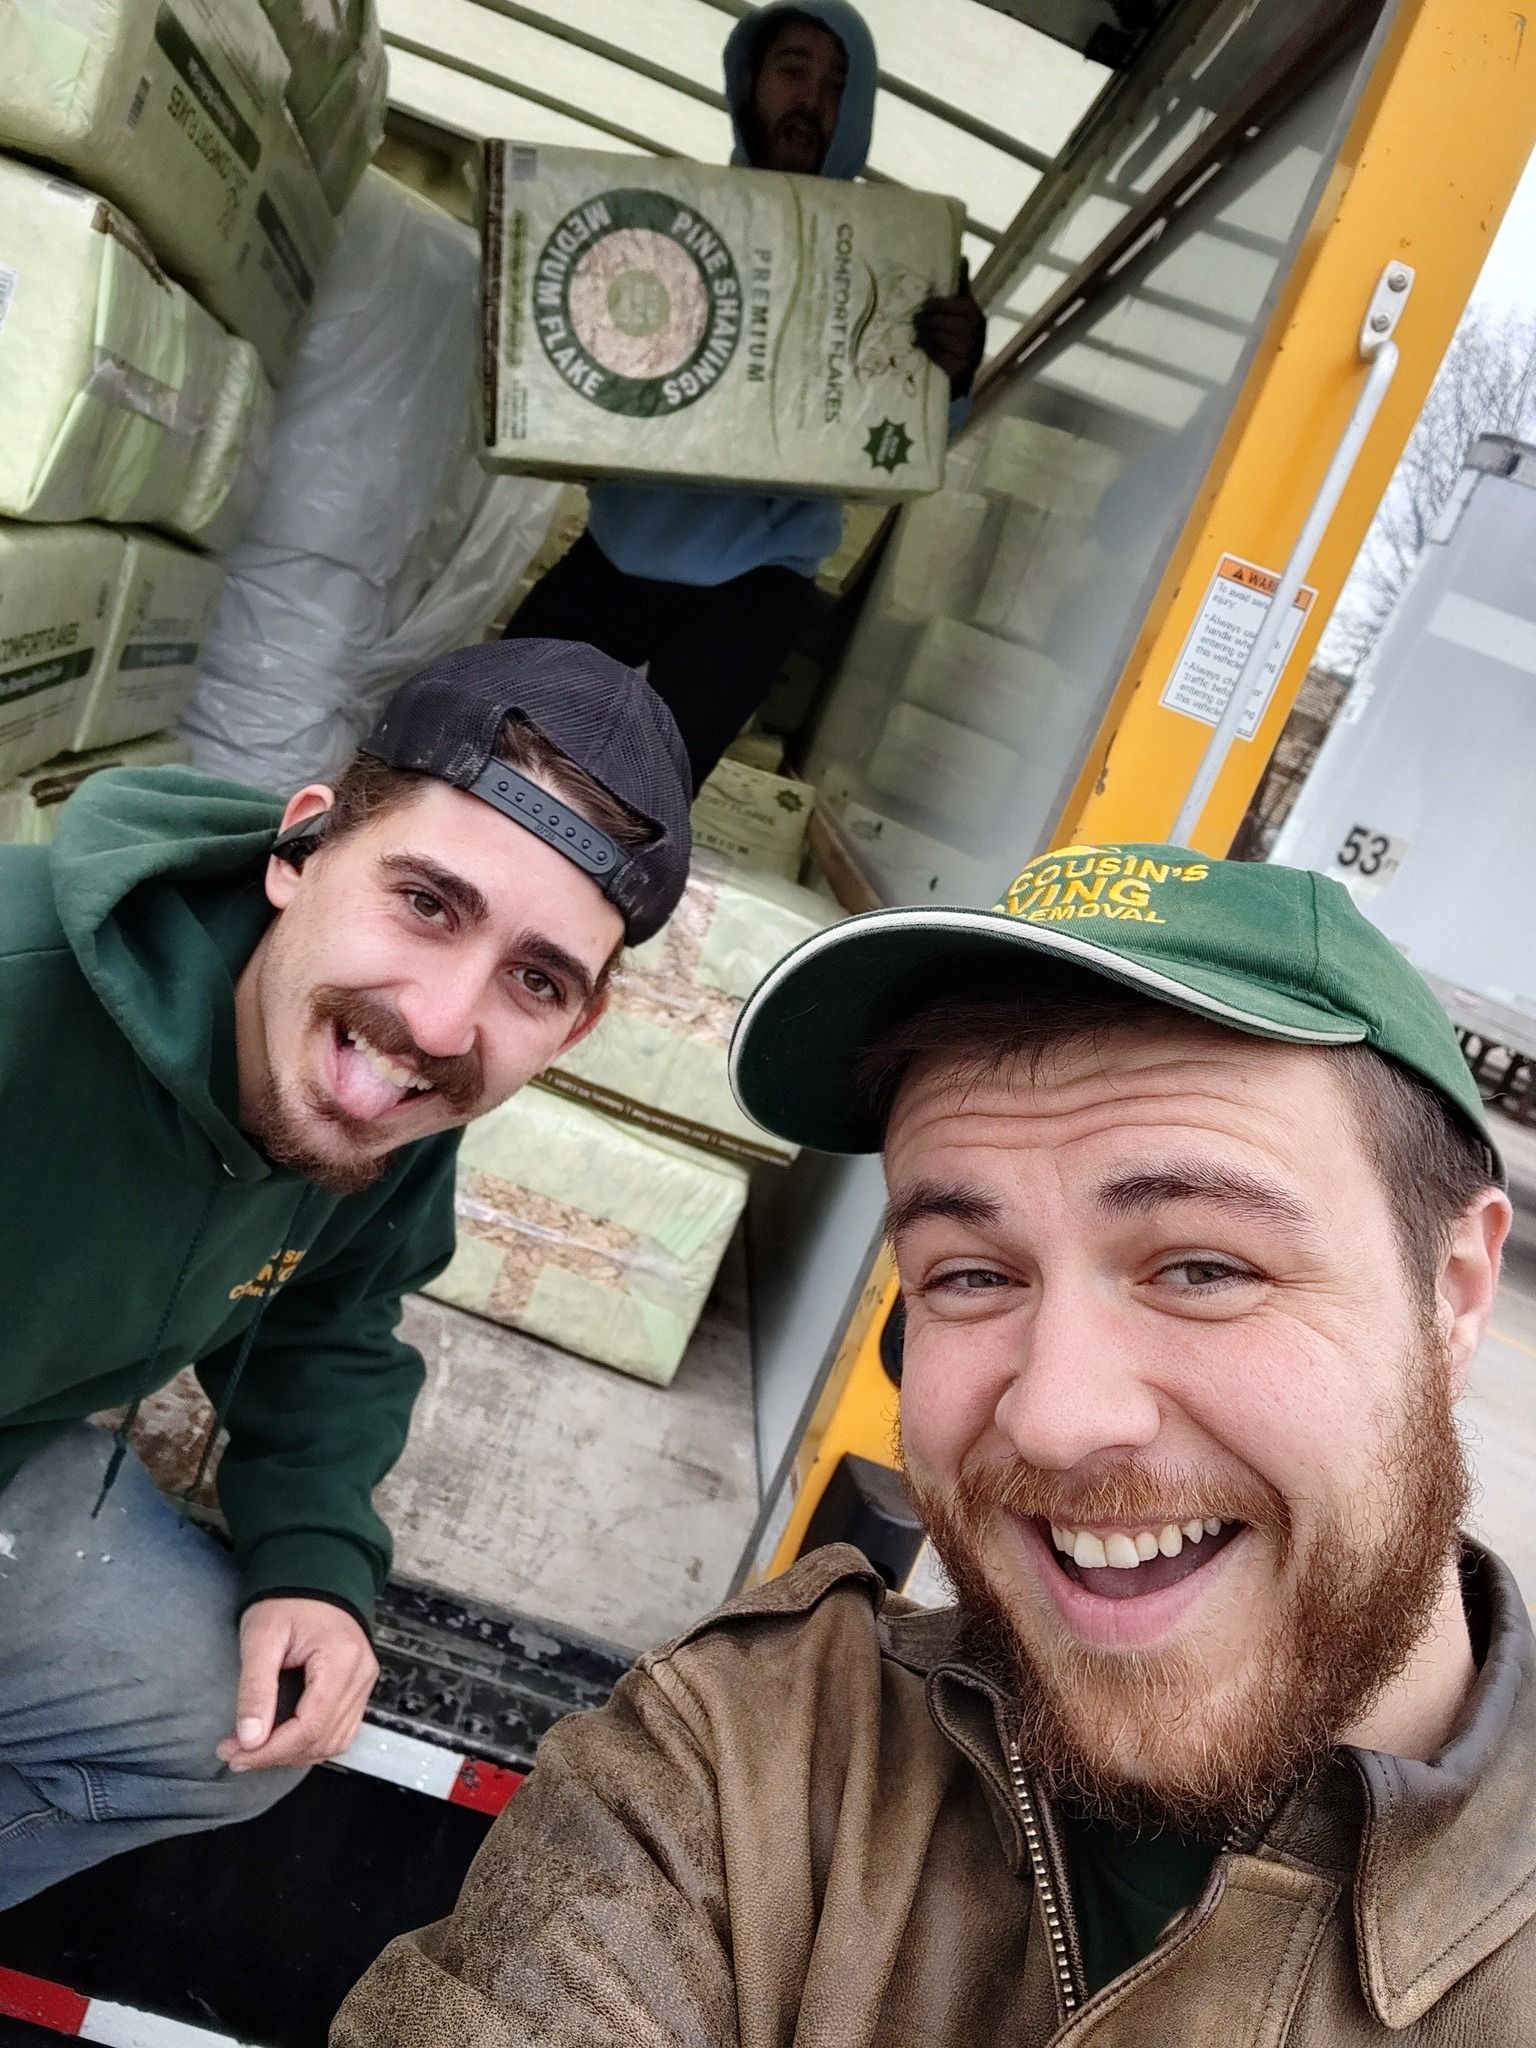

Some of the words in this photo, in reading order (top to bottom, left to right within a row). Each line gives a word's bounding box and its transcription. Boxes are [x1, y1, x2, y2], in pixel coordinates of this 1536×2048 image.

[537, 201, 611, 306] MEDIUM
[671, 212, 728, 274] PINE
[832, 223, 854, 332] COMFORT
[540, 315, 605, 397] FLAKE
[662, 278, 740, 405] SHAVINGS
[746, 249, 772, 382] PREMIUM
[824, 341, 847, 423] FLAKES
[1008, 855, 1210, 897] COUSIN'S
[1338, 826, 1388, 875] 53
[1007, 876, 1152, 915] VING
[1020, 902, 1167, 924] EMOVAL
